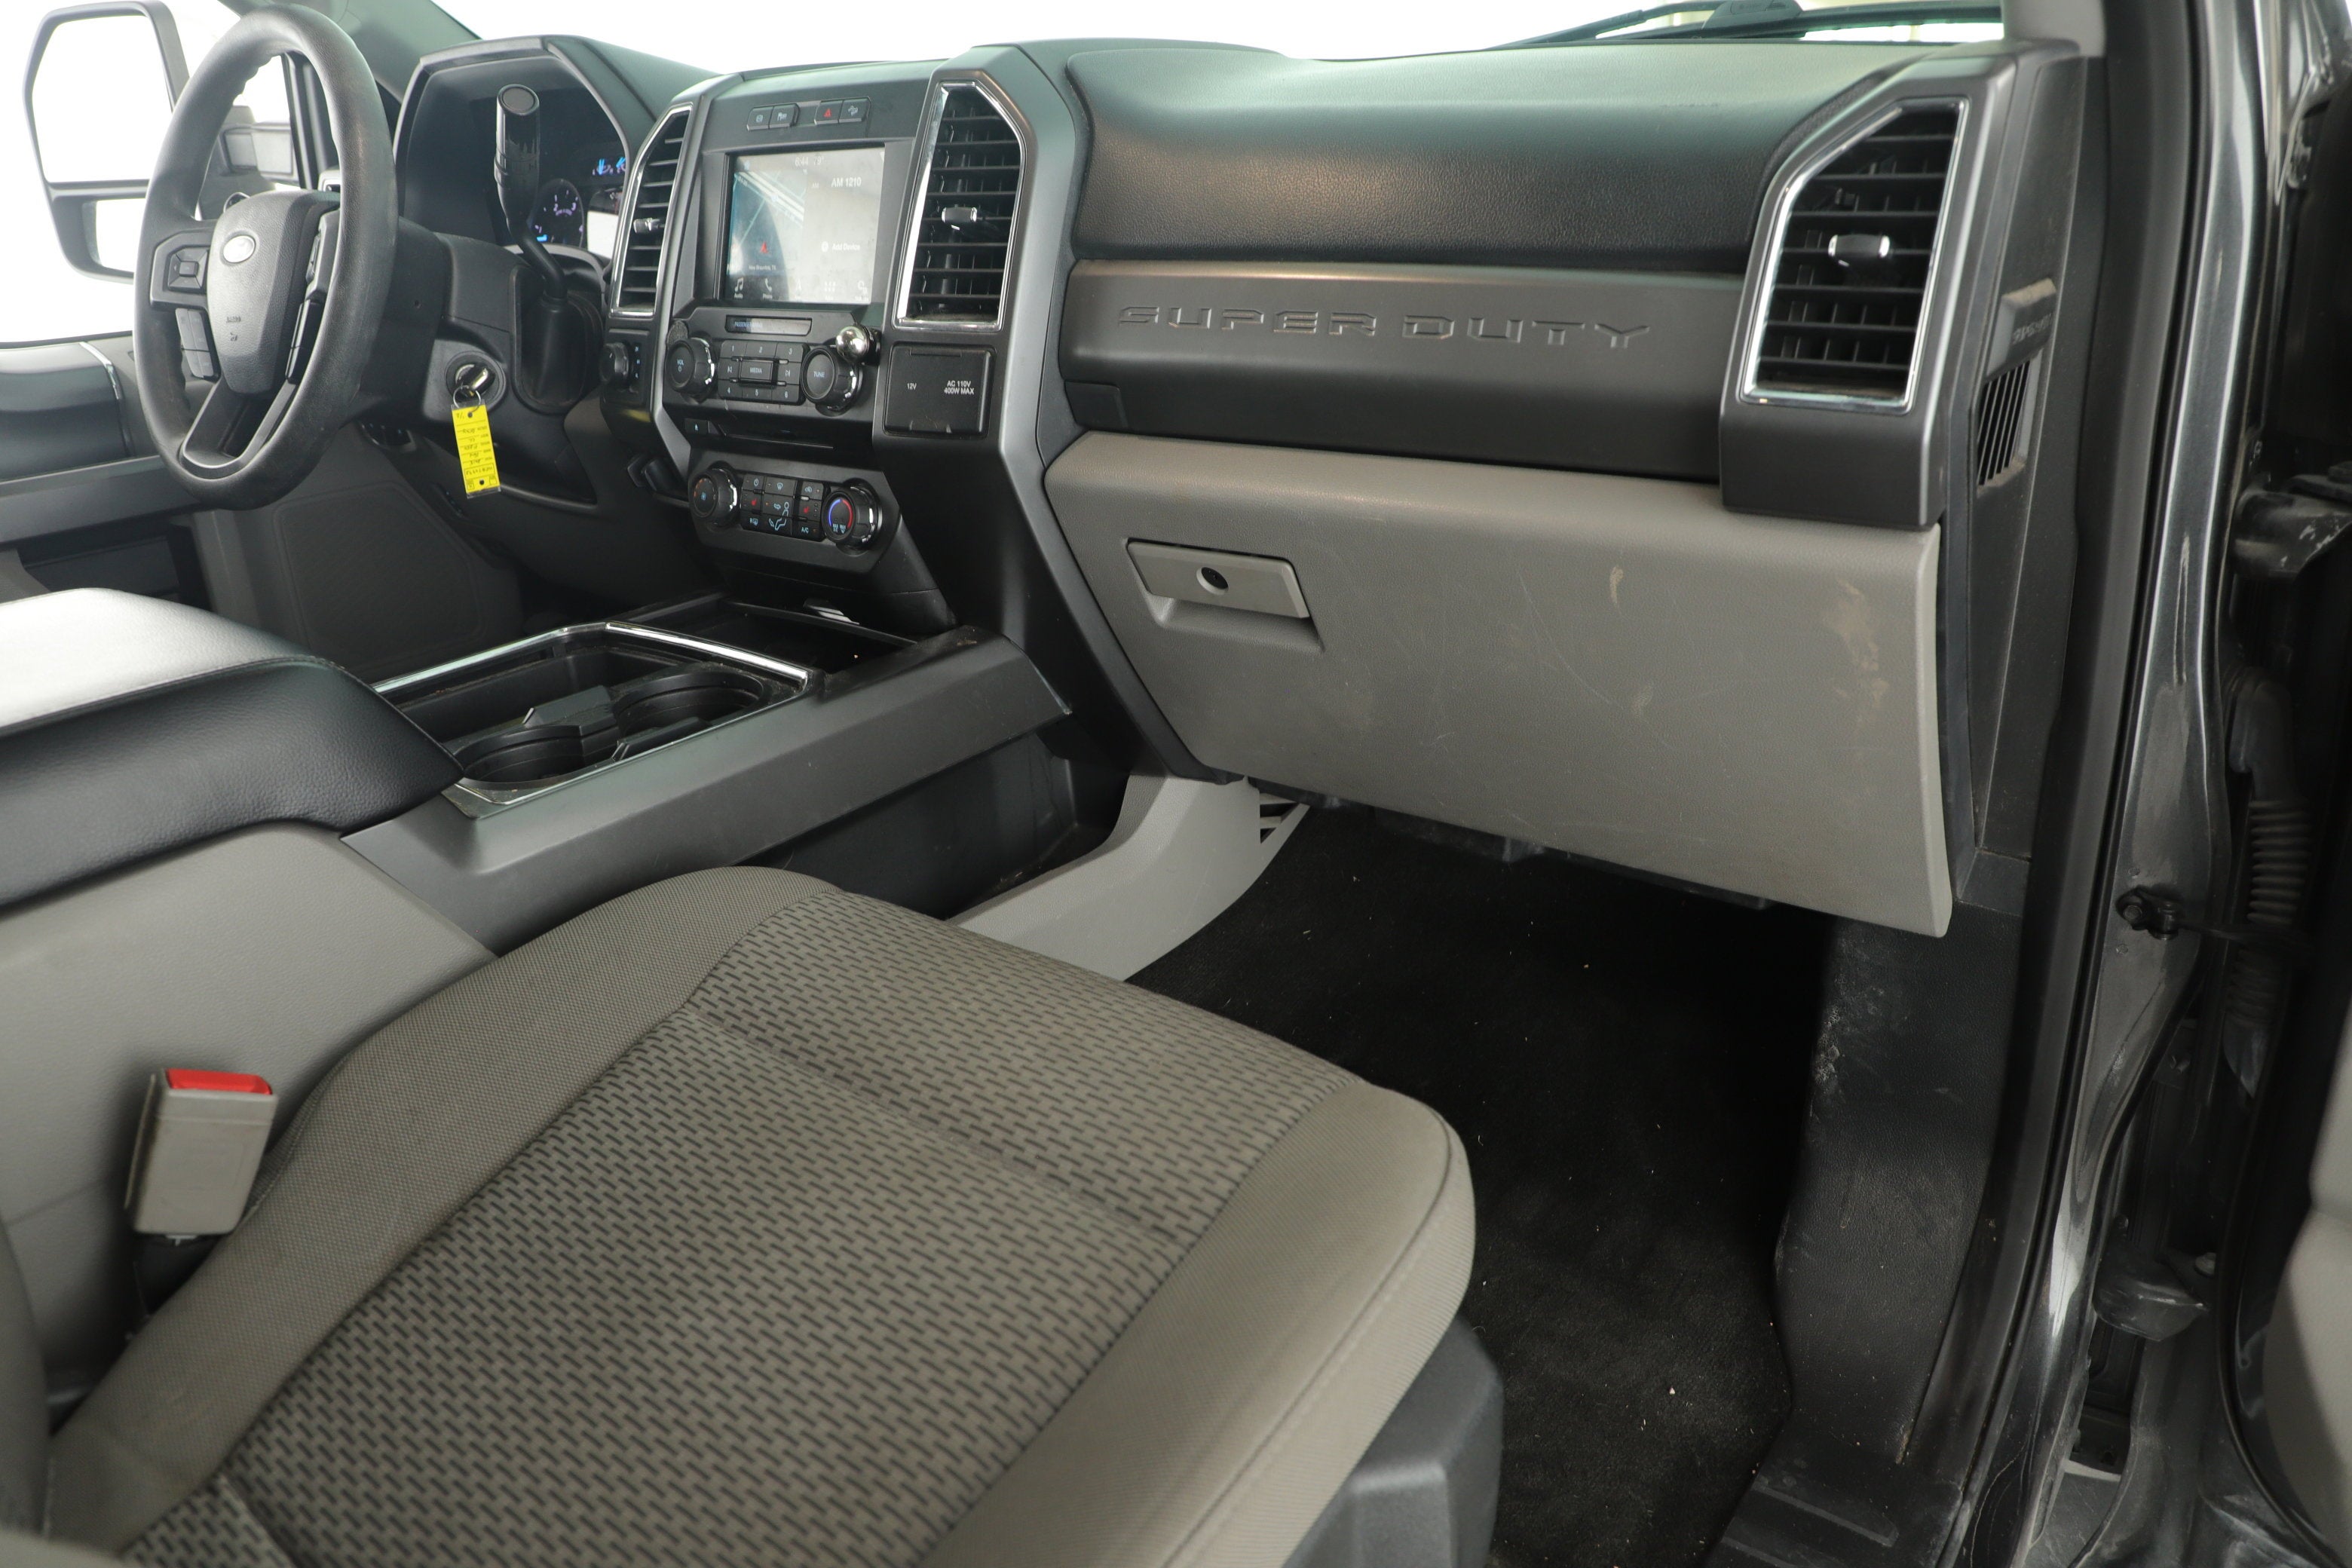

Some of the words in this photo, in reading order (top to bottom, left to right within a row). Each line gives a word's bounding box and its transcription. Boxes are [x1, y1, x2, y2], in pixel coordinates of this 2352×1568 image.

[831, 176, 844, 188] AM
[845, 176, 862, 188] 1210
[832, 243, 842, 251] Add
[843, 243, 860, 251] Device
[1119, 305, 1377, 337] SUPER
[1401, 314, 1650, 349] DUTY
[906, 382, 917, 391] 12V
[957, 380, 972, 388] 110V
[960, 387, 975, 396] MAX
[801, 526, 809, 534] A/C
